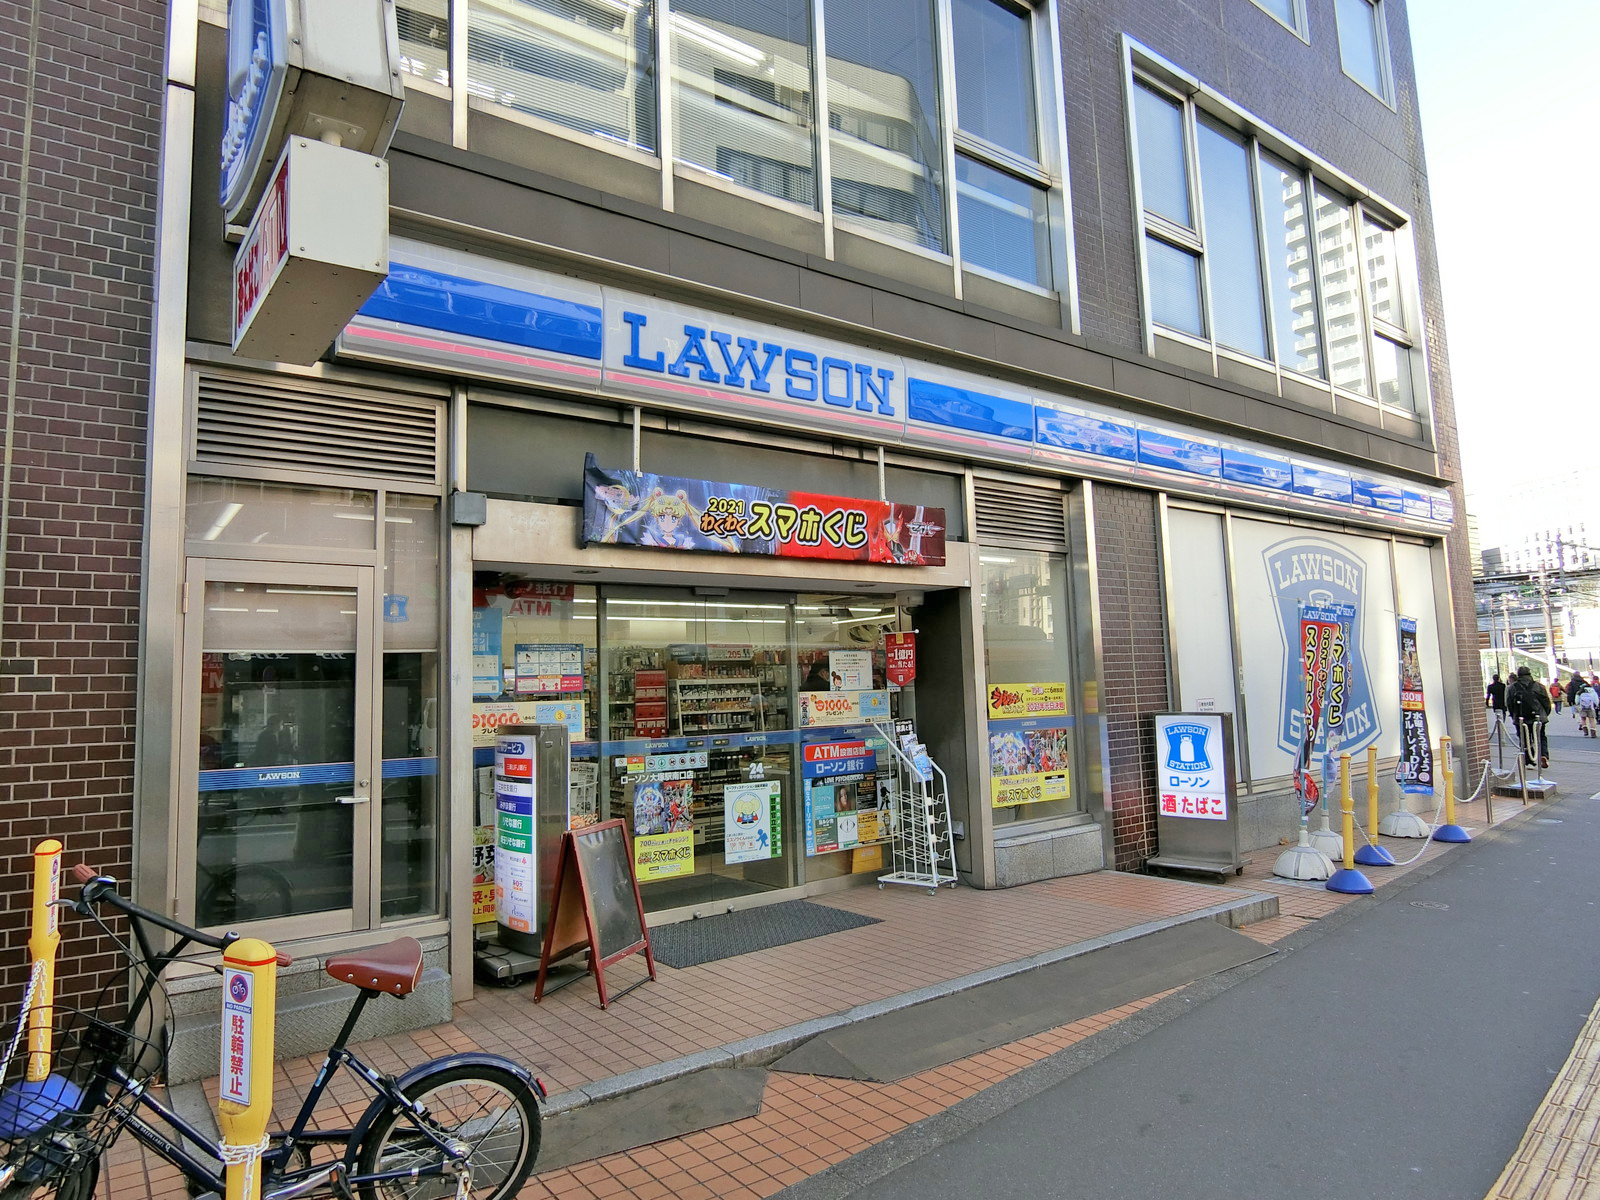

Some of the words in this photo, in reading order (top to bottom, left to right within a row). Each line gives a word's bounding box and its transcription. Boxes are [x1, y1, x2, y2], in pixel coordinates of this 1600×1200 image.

[262, 173, 289, 284] ATM
[623, 311, 895, 415] LAWSON
[707, 496, 745, 516] 2021
[699, 513, 748, 537] わくわく
[750, 502, 869, 547] スマホくじ
[1275, 553, 1358, 596] LAWSON
[509, 599, 552, 617] ATM
[1303, 609, 1338, 622] LAWSON
[1167, 725, 1207, 736] LAWSON
[749, 762, 764, 774] 24
[816, 759, 864, 774] ローソン銀行
[1169, 760, 1209, 771] STATION
[259, 771, 301, 781] LAWSON
[1169, 776, 1210, 788] ローソン
[1008, 786, 1042, 801] スマホくじ
[1162, 794, 1223, 815] 酒・たばこ
[503, 817, 523, 830] りそな銀行
[652, 846, 691, 862] スマホくじ
[233, 1004, 252, 1014] PARKING
[229, 1014, 245, 1096] 駐輪禁止
